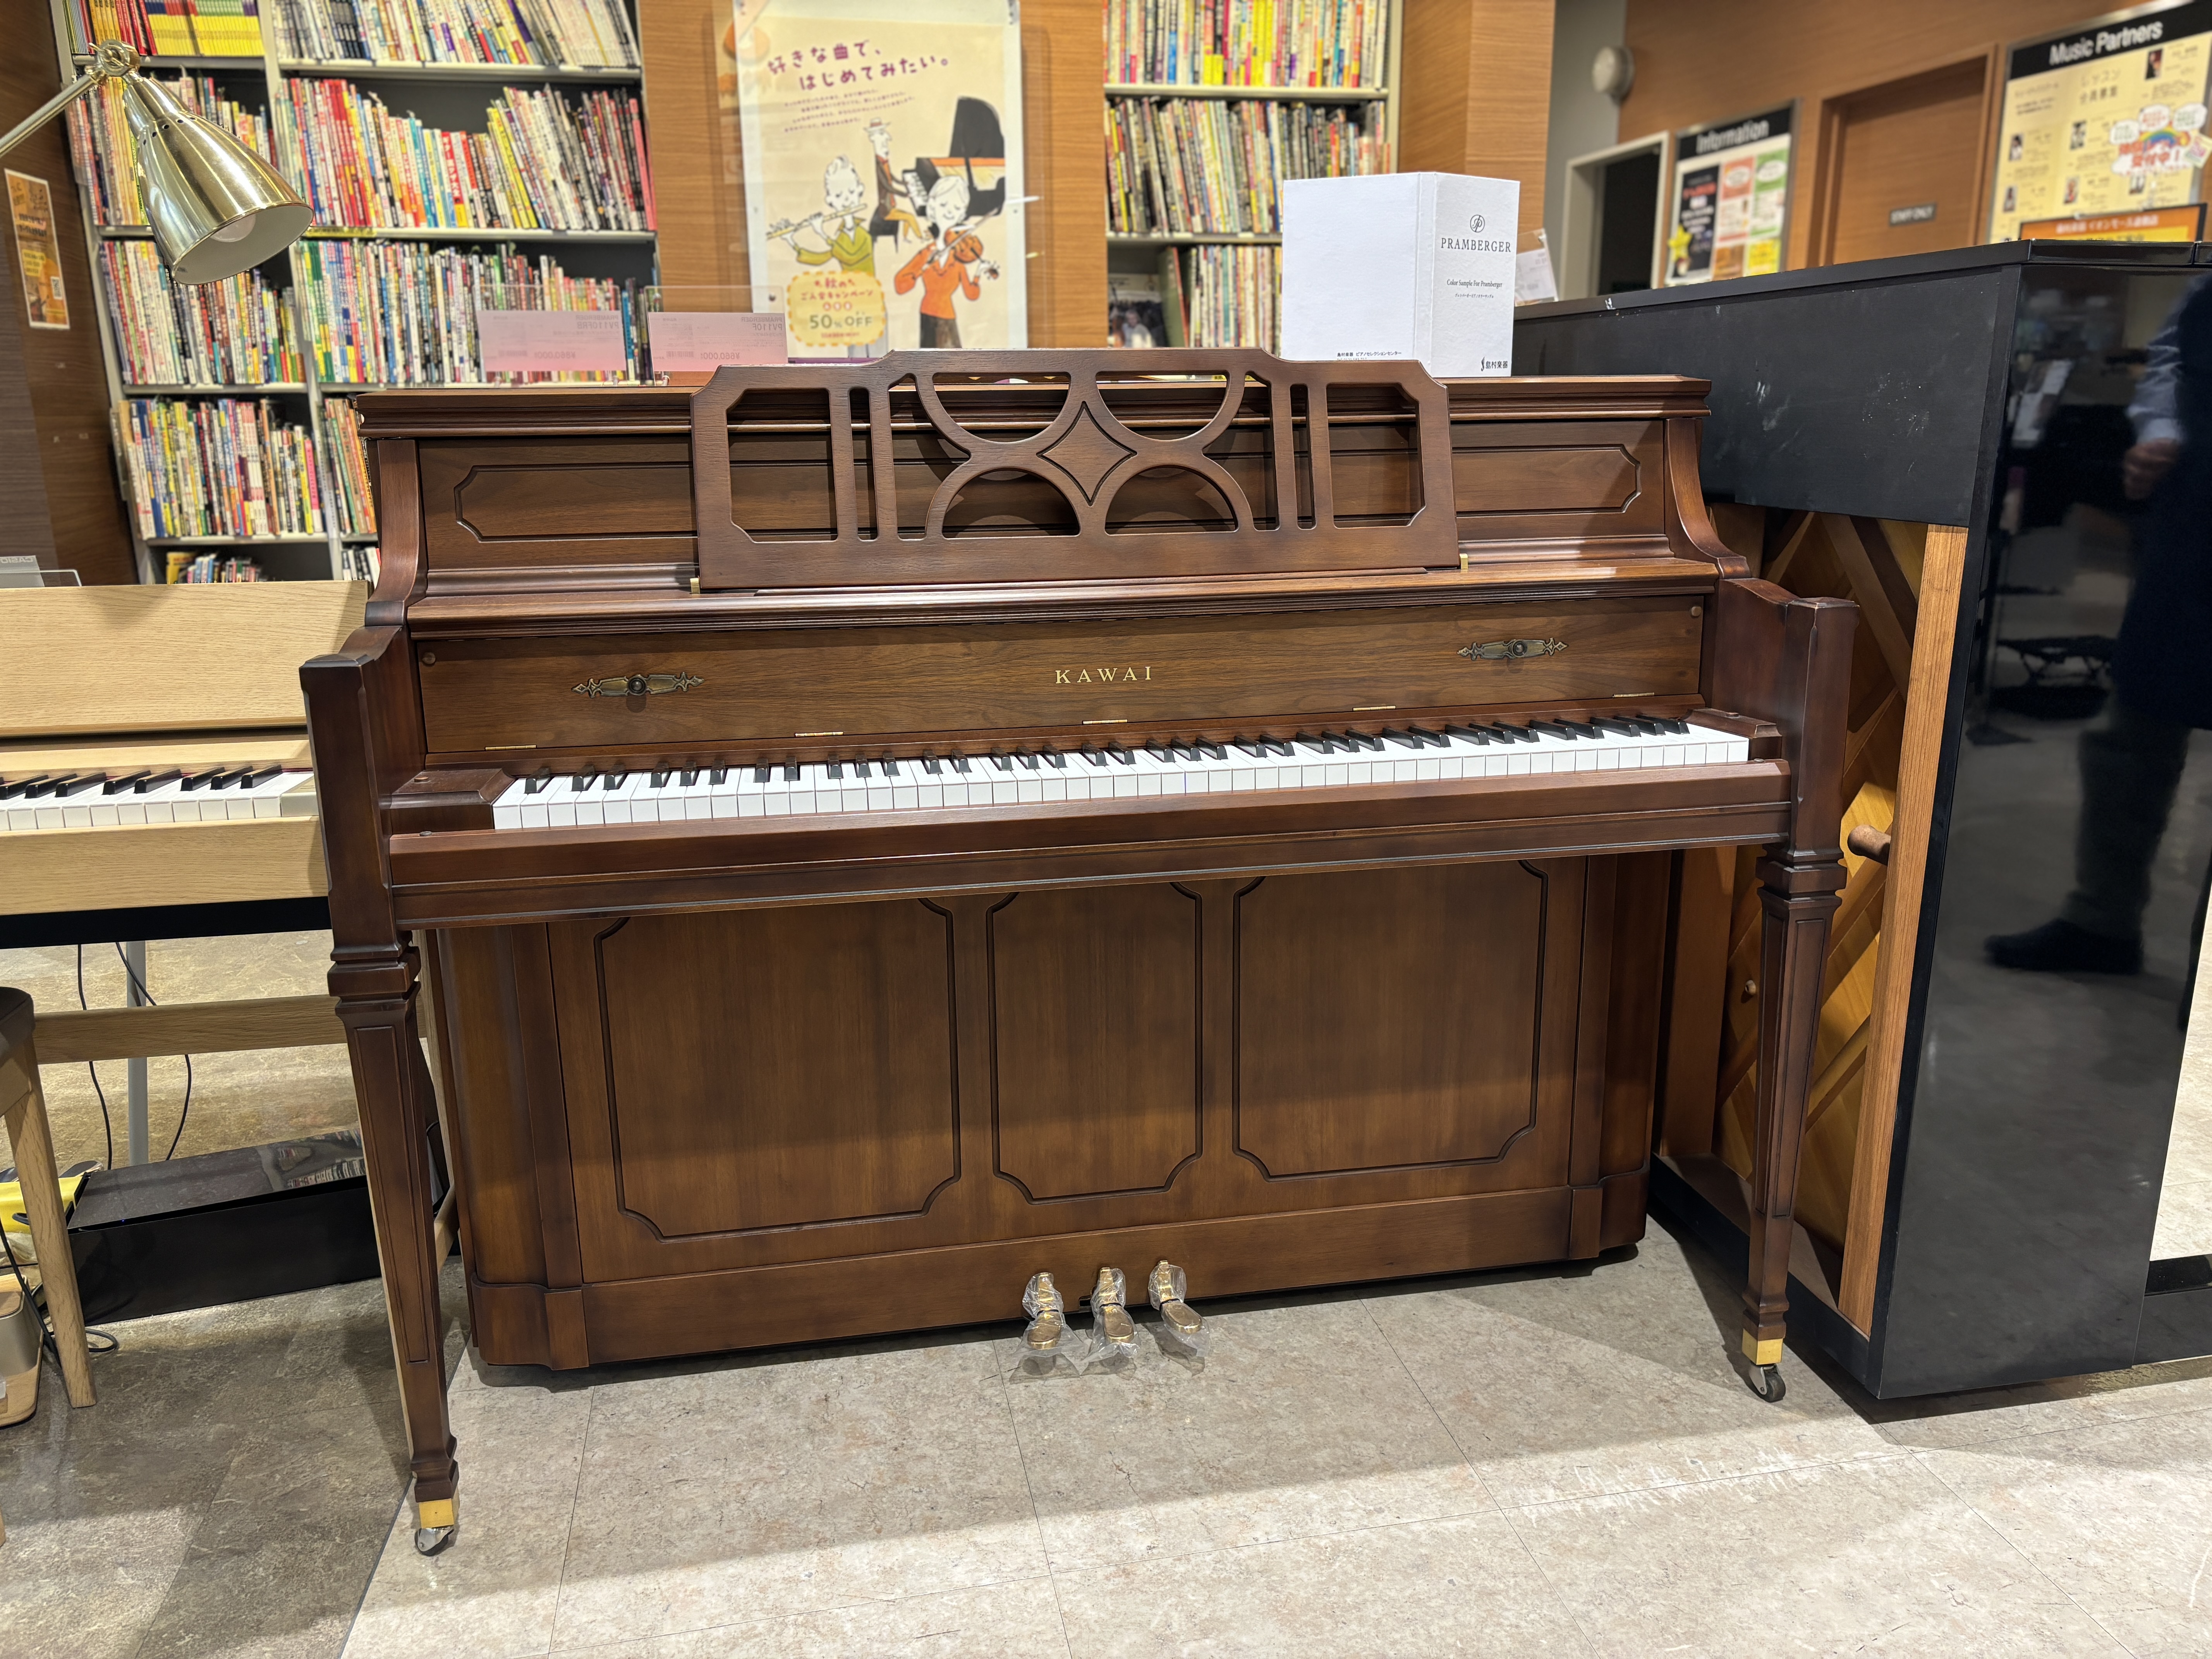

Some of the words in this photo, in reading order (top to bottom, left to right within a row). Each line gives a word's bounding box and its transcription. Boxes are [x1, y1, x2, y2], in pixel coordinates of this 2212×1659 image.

[2049, 38, 2093, 65] Music
[2095, 21, 2164, 54] Partners
[768, 40, 881, 74] 好きな曲で、
[799, 56, 948, 90] はじめてみたい。
[1696, 118, 1769, 154] Information
[1441, 237, 1511, 252] PRAMBERGER
[1458, 279, 1472, 288] Sample
[1480, 280, 1503, 289] Pramberger
[844, 315, 872, 328] OFF
[1486, 361, 1508, 369] 島村楽器
[1055, 666, 1151, 684] KAWAI
